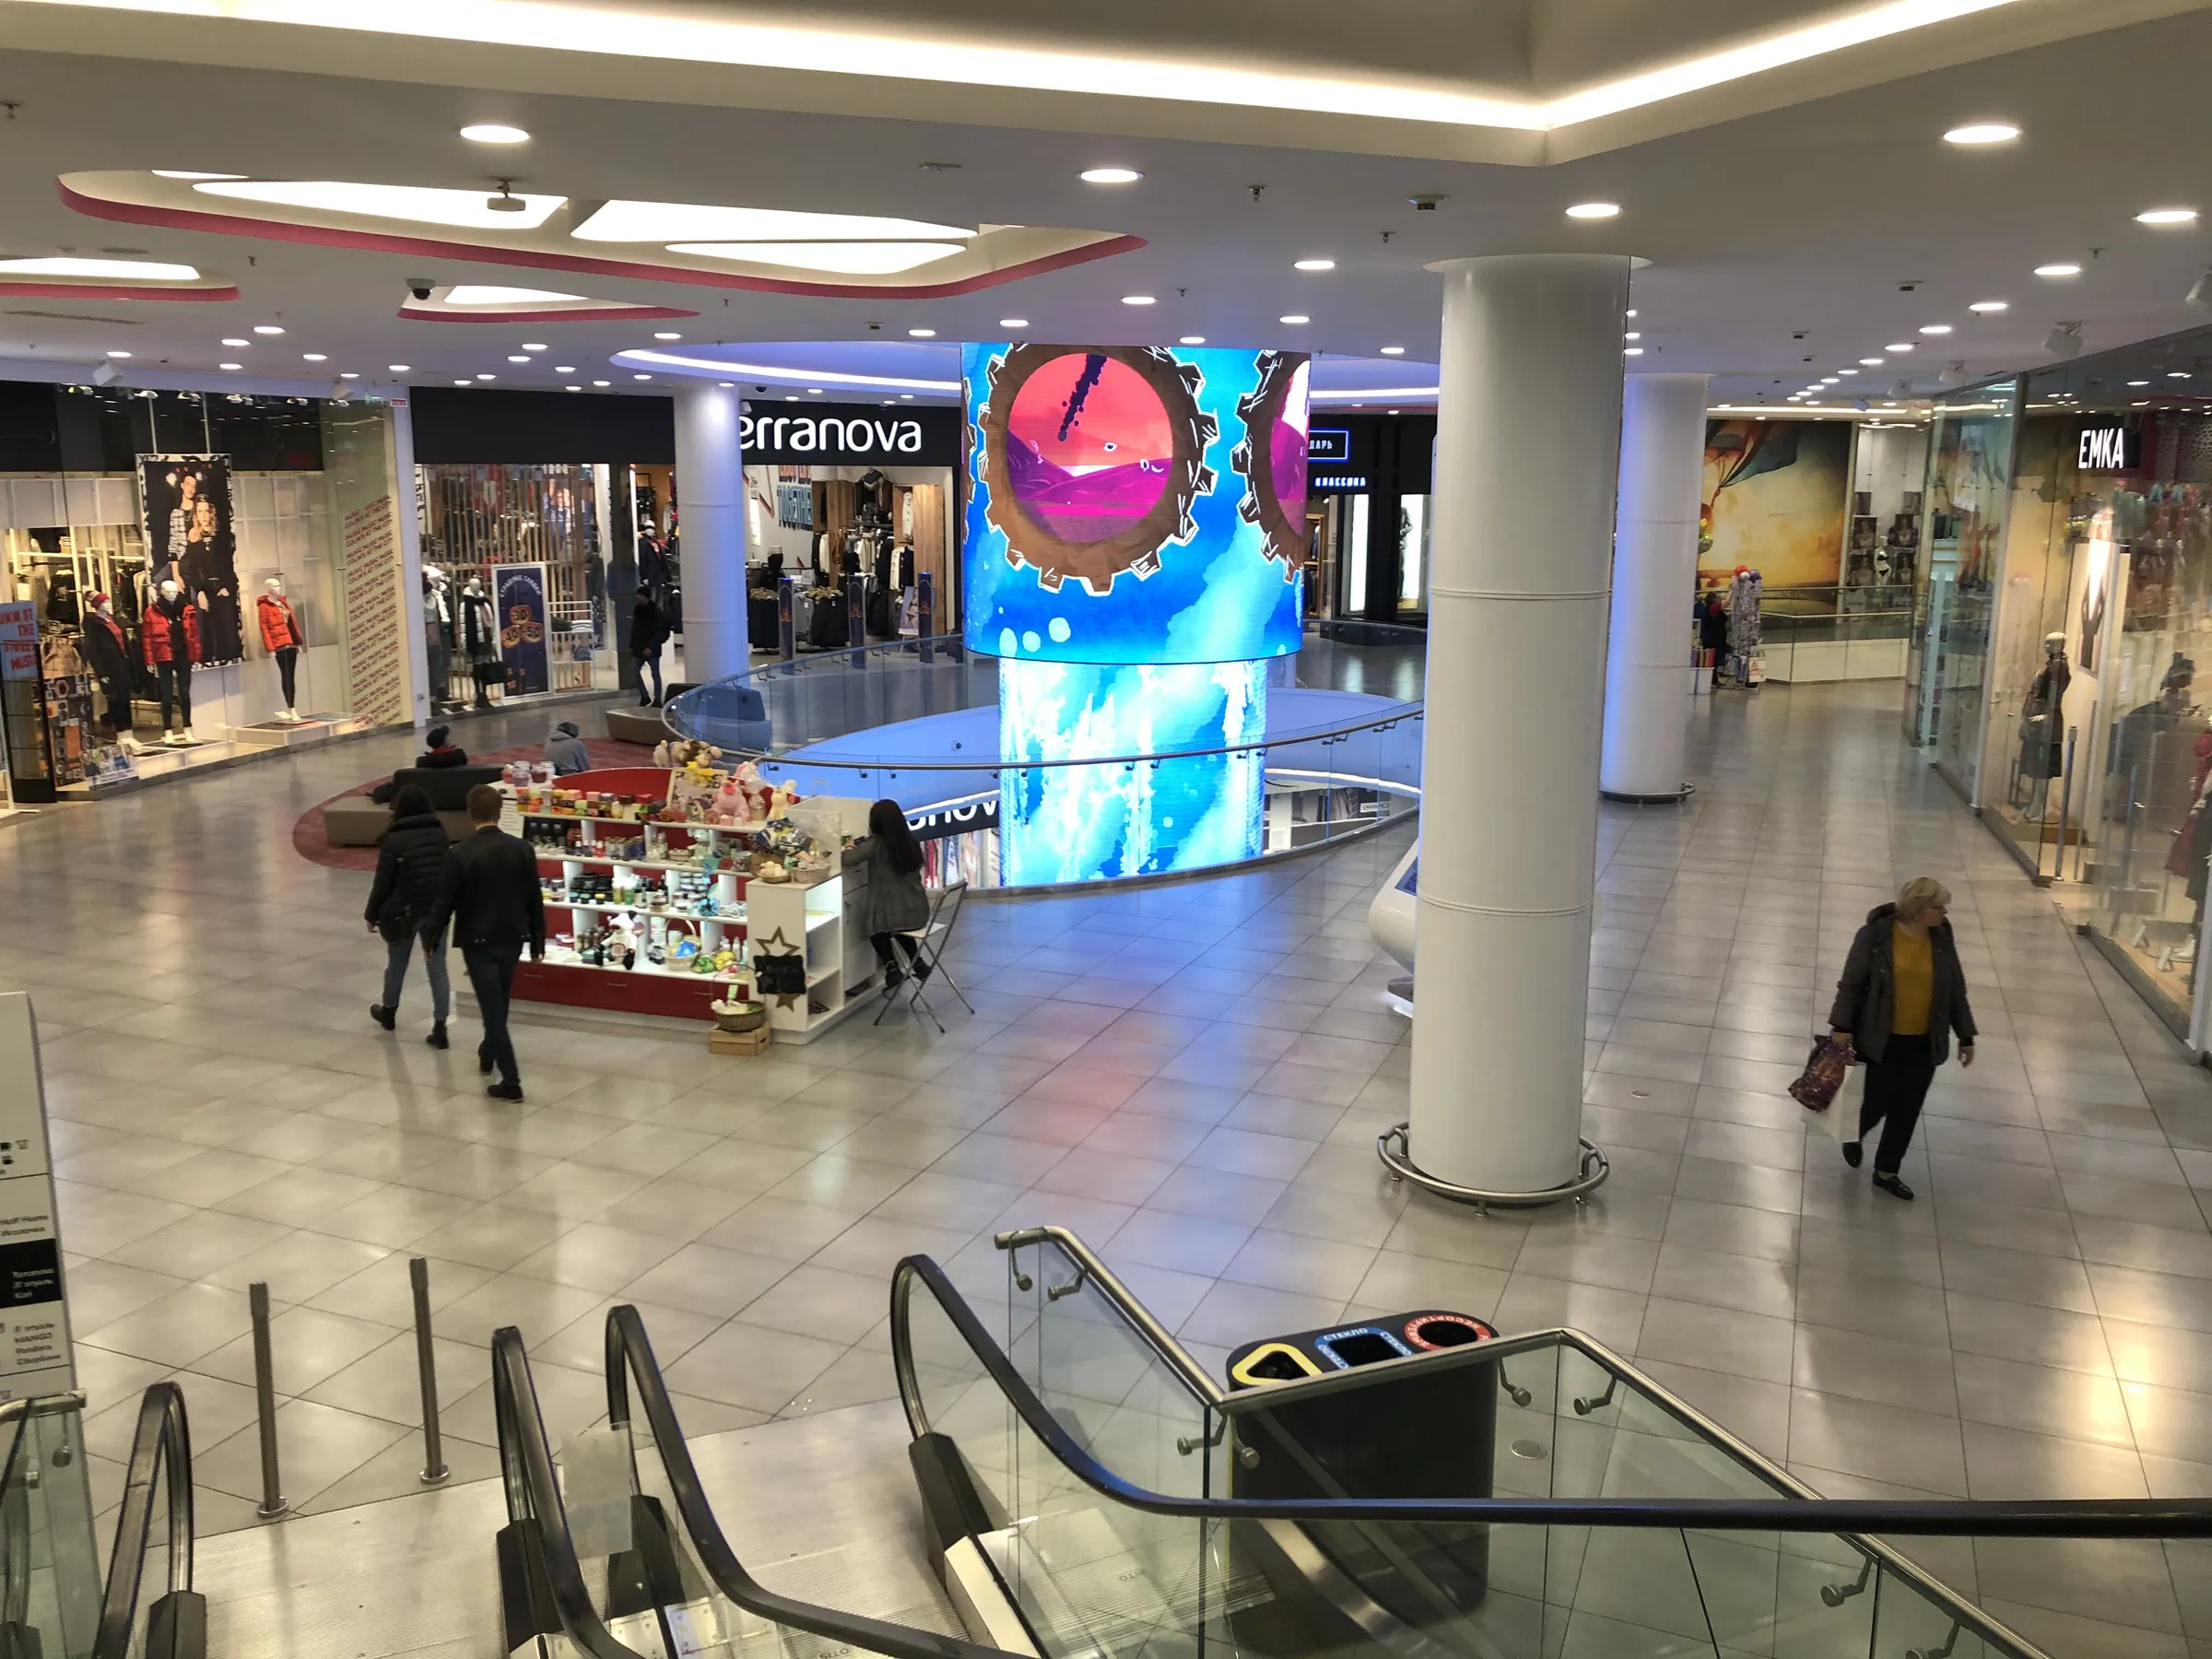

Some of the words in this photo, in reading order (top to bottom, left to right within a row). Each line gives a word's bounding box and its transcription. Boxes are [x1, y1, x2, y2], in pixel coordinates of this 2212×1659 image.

[738, 416, 922, 453] erranova
[1309, 440, 1333, 450] ДАРЬ
[2077, 427, 2124, 469] EMKA
[1314, 477, 1366, 488] КЛАССИКА
[1323, 1327, 1369, 1341] СТЕКЛО
